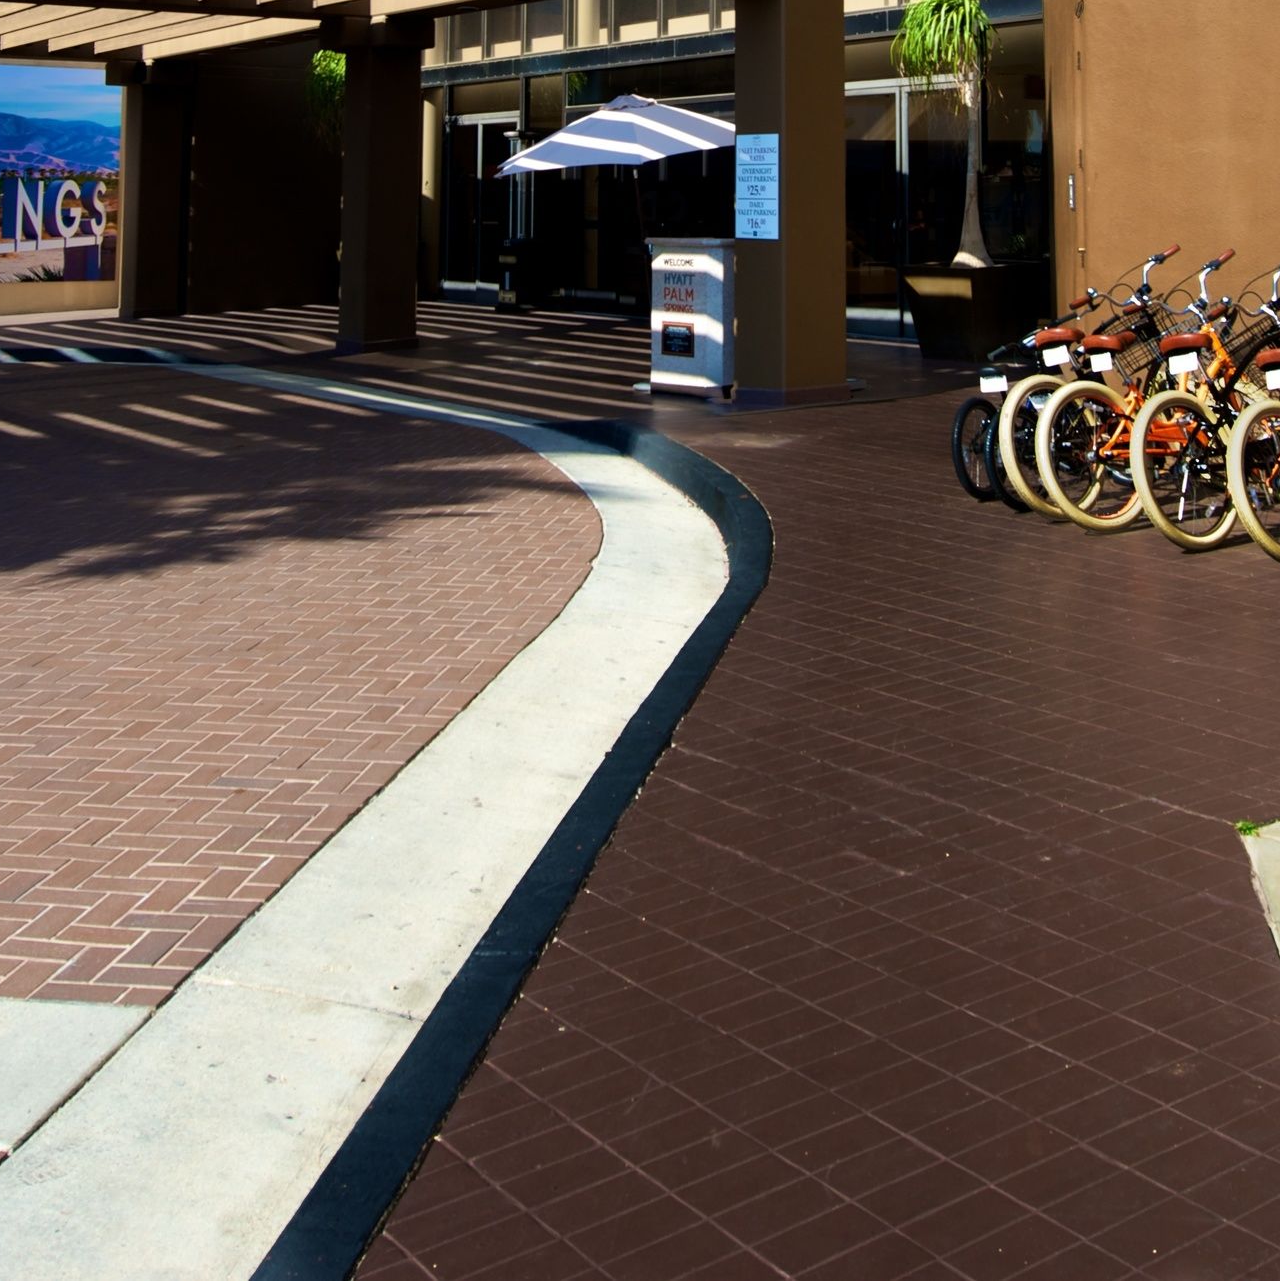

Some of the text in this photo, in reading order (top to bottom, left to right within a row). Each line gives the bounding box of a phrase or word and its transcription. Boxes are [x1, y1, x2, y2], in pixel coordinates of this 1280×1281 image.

[664, 259, 694, 267] WELCOME
[664, 273, 696, 286] HYATT
[663, 287, 694, 302] PALM
[663, 303, 694, 314] SPRINGS
